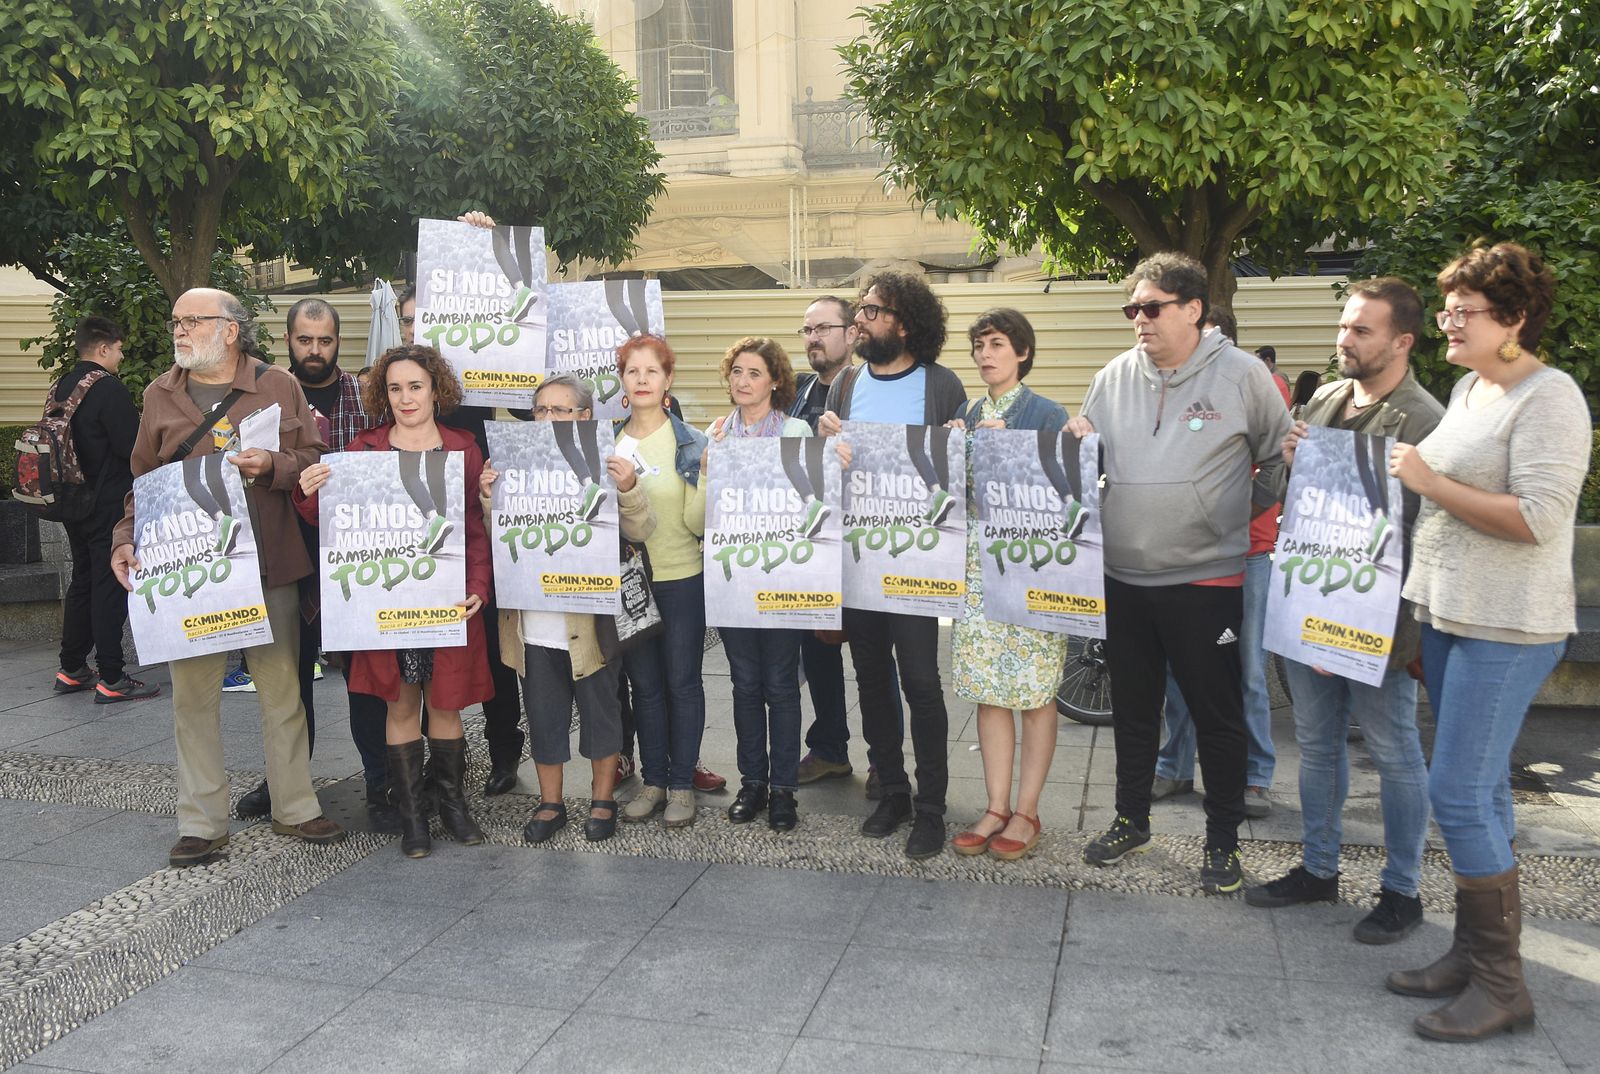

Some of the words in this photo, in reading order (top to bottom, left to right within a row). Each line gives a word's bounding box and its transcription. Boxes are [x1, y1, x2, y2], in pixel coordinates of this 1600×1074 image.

[431, 269, 454, 294] SI
[463, 271, 511, 298] NOS
[430, 295, 511, 312] MOVEMOS
[422, 312, 502, 324] CAMBIAMOS
[422, 323, 520, 354] TODO
[554, 329, 576, 352] SI
[582, 326, 628, 350] NOS
[556, 351, 616, 368] MOVEM
[465, 372, 537, 383] CAMINANDO
[504, 469, 525, 494] SI
[534, 470, 580, 496] NOS
[851, 470, 872, 495] SI
[881, 473, 928, 500] NOS
[504, 496, 580, 512] MOVEMOS
[721, 488, 744, 512] SI
[752, 488, 800, 512] NOS
[852, 496, 928, 516] MOVEMOS
[986, 480, 1008, 506] SI
[1013, 484, 1062, 512] NOS
[1298, 486, 1326, 518] SI
[1330, 492, 1373, 528] NOS
[140, 520, 158, 547] SI
[162, 508, 214, 540] NOS
[335, 504, 360, 529] SI
[370, 504, 424, 529] NOS
[498, 512, 574, 526] CAMBIAMOS
[721, 515, 802, 530] MOVEMOS
[843, 514, 922, 528] CAMBIAMOS
[990, 508, 1064, 528] MOVEMOS
[336, 531, 424, 548] MOVEMOS
[500, 523, 592, 564] TODO
[712, 529, 794, 545] CAMBIAMOS
[985, 525, 1058, 540] CAMBIAMOS
[1294, 518, 1369, 548] MOVEMOS
[140, 534, 216, 564] MOVEMOS
[328, 545, 416, 564] CAMBIAMOS
[843, 526, 940, 564] TODO
[986, 538, 1076, 576] TODO
[1283, 538, 1363, 563] CAMBIAMOS
[135, 550, 213, 580] CAMBIAMOS
[712, 540, 814, 582] TODO
[136, 558, 232, 614] TODO
[329, 556, 436, 602] TODO
[542, 575, 613, 586] CAMINANDO
[884, 576, 957, 591] CAMINANDO
[1280, 556, 1377, 598] TODO
[758, 593, 833, 602] CAMINANDO
[1028, 590, 1097, 608] CAMINANDO
[184, 608, 258, 628] CAMINANDO
[240, 616, 262, 624] octubre
[379, 609, 458, 620] CAMINANDO
[1305, 618, 1383, 648] CAMINANDO
